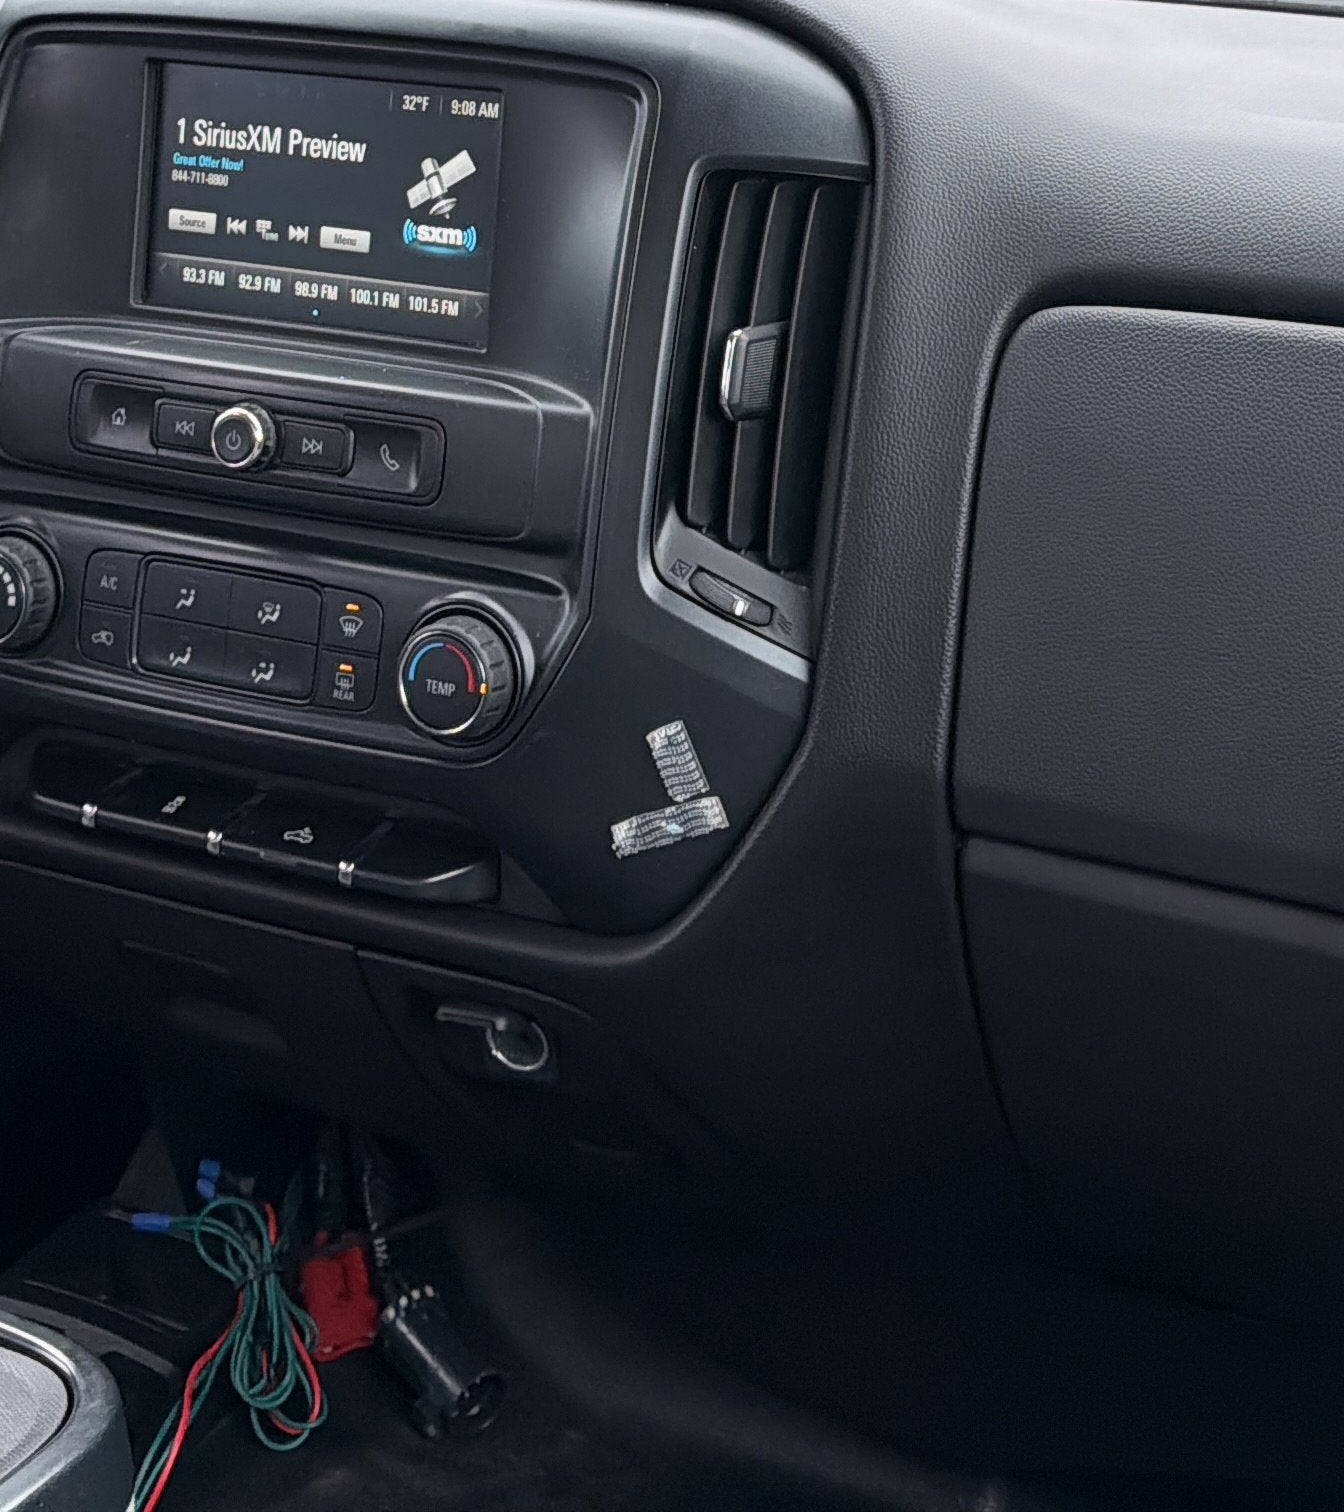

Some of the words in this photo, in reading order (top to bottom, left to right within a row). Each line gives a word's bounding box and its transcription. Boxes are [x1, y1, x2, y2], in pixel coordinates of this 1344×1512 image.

[402, 95, 430, 113] 32°F
[450, 99, 476, 116] 9:08
[477, 102, 499, 119] AM
[176, 117, 186, 144] 1
[193, 119, 281, 155] SiriusXM
[288, 129, 367, 163] Preview
[173, 152, 197, 169] Great
[198, 155, 219, 170] Offer
[221, 157, 244, 172] Now!
[178, 215, 207, 230] Source
[334, 233, 357, 247] Menu
[416, 223, 464, 246] sxm
[182, 267, 206, 284] 93.3
[207, 271, 225, 287] FM
[238, 274, 262, 291] 92.9
[264, 277, 281, 294] FM
[294, 281, 319, 298] 98.9
[320, 285, 338, 301] FM
[350, 288, 380, 305] 100.1
[382, 293, 400, 309] FM
[408, 296, 439, 313] 101.5
[440, 300, 459, 317] FM
[100, 574, 119, 591] A/C
[332, 689, 356, 703] REAR
[425, 678, 457, 697] TEMP
